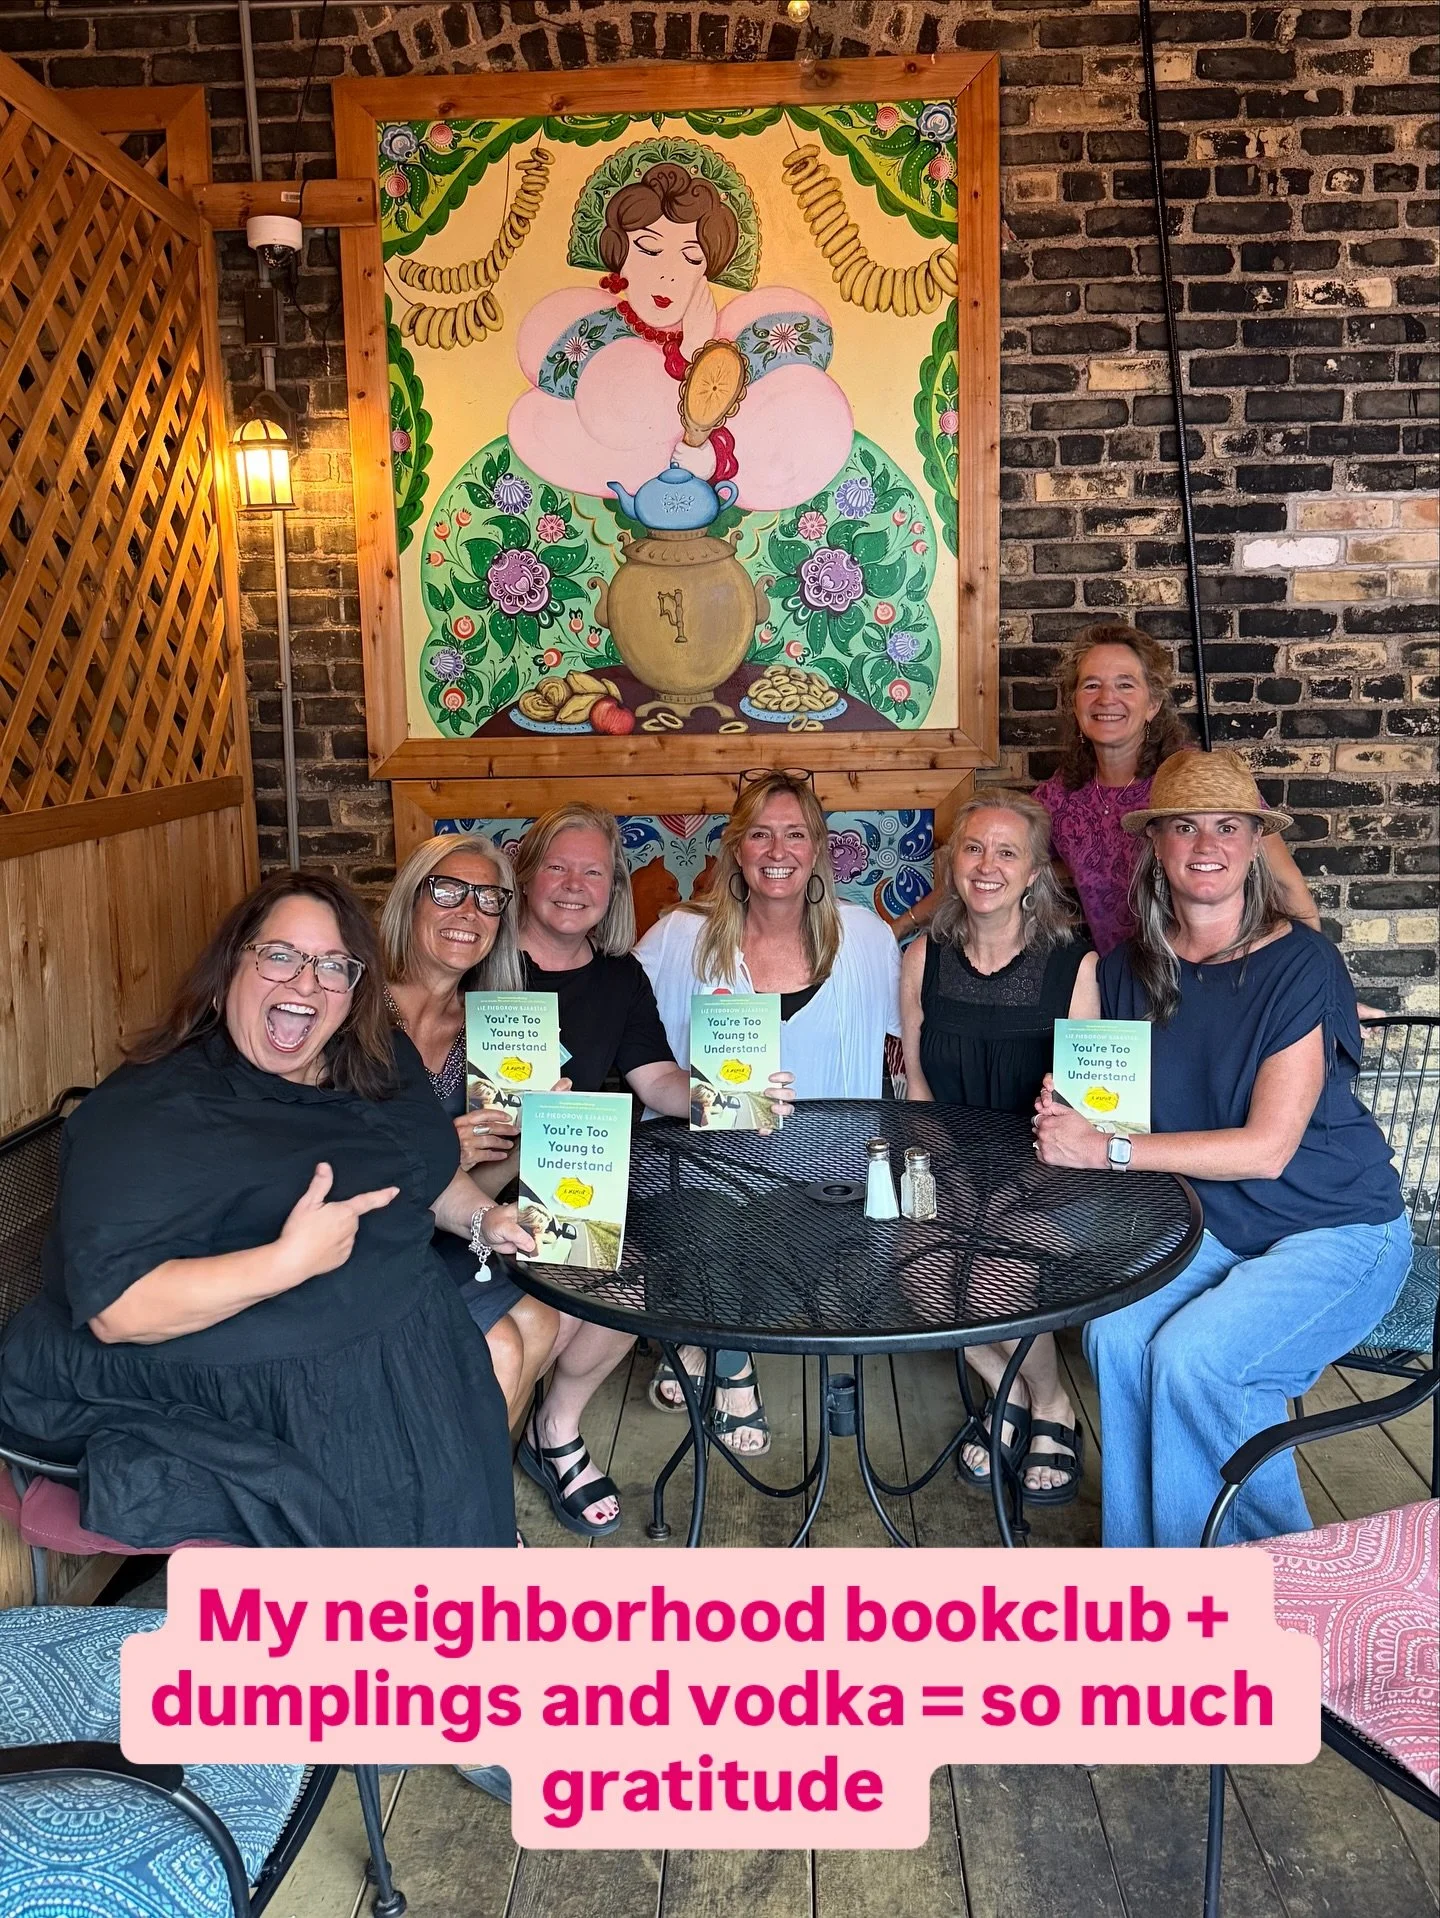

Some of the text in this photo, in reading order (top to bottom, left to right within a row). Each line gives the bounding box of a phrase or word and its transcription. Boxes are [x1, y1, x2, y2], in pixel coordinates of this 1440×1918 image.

[484, 1014, 541, 1024] You're Too
[707, 1017, 762, 1027] You're Too
[490, 1028, 539, 1039] Young to
[712, 1031, 759, 1041] Young to
[482, 1042, 547, 1052] Understand
[704, 1044, 767, 1054] Understand
[1072, 1043, 1131, 1054] You're Too
[1077, 1056, 1128, 1069] Young to
[1068, 1070, 1136, 1082] Understand
[543, 1123, 609, 1138] You're Too
[548, 1141, 604, 1156] Young to
[537, 1157, 613, 1172] Understand
